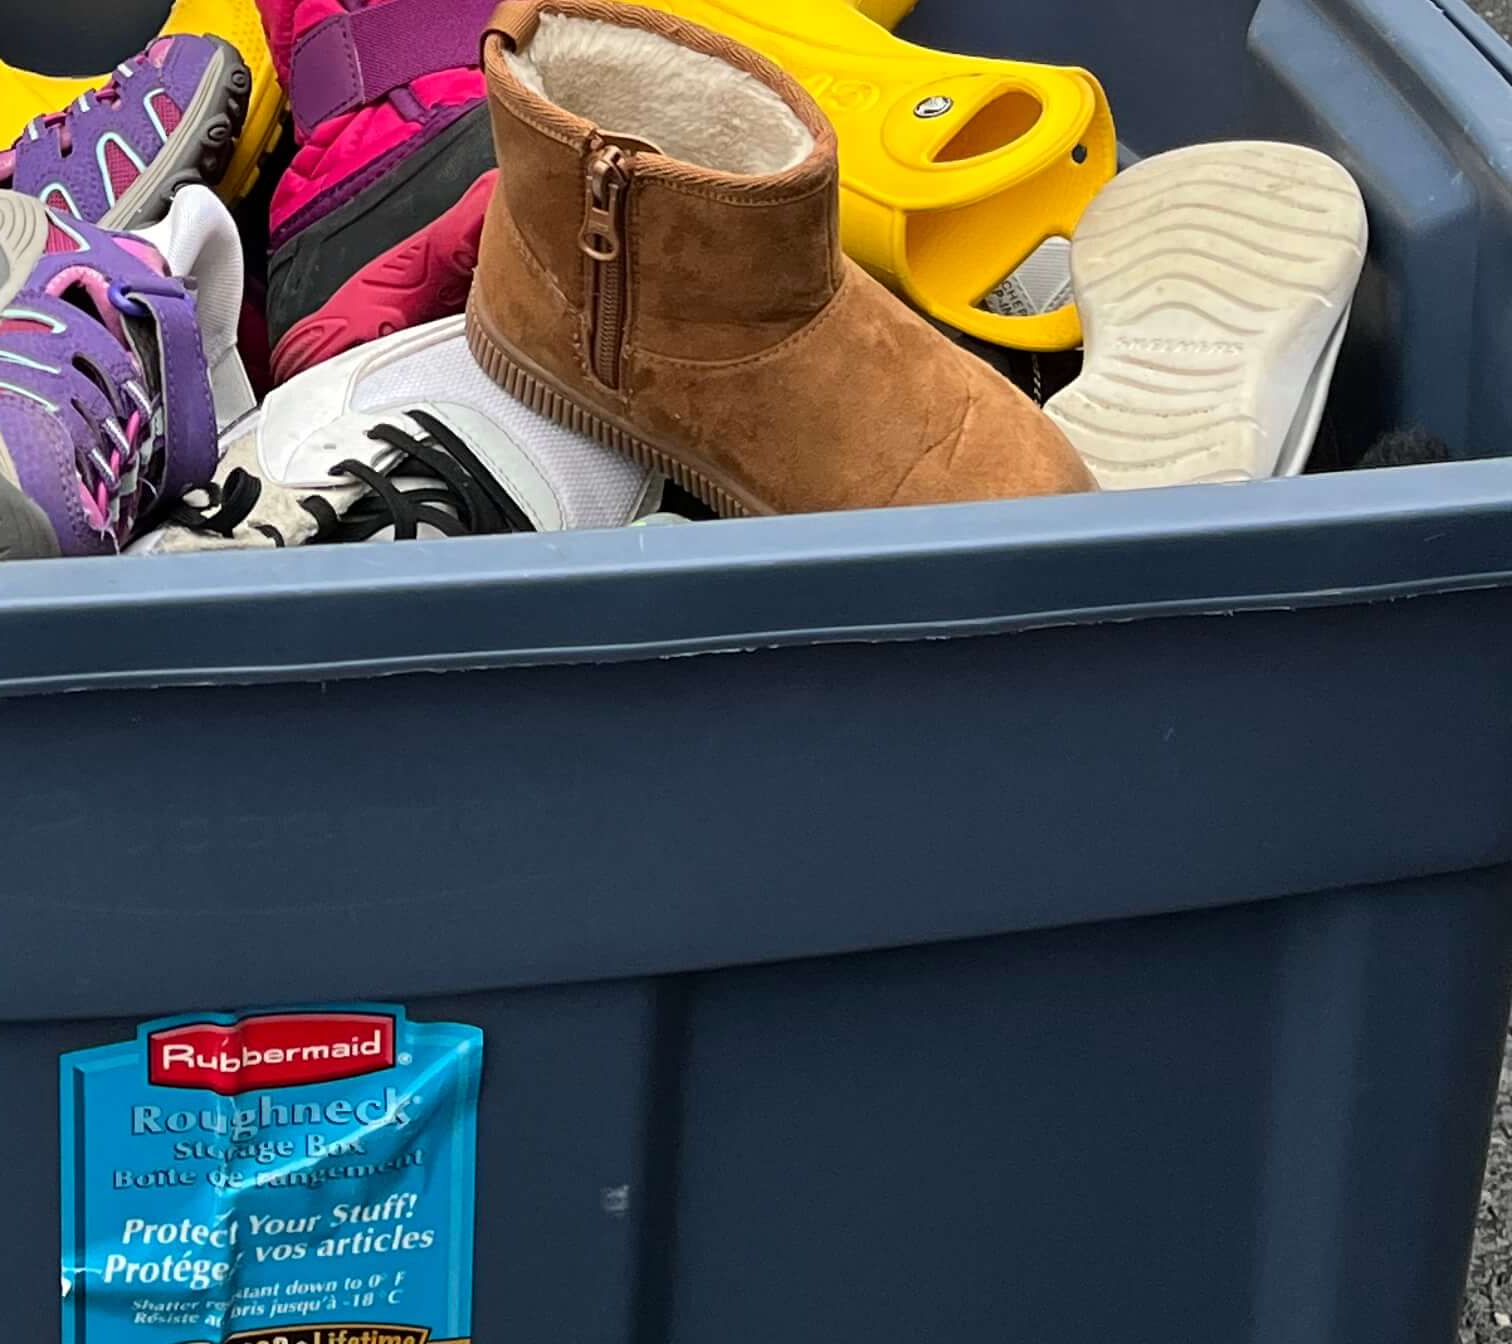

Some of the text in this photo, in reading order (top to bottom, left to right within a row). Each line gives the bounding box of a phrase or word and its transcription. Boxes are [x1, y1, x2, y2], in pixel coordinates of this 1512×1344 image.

[162, 1028, 381, 1073] Rubbermaid
[132, 1087, 412, 1142] Roughneck
[174, 1134, 366, 1163] Storage Box
[122, 1192, 418, 1249] Protect Your Stuff!
[255, 1242, 308, 1263] vos
[316, 1224, 436, 1258] articles
[285, 1279, 339, 1296] down
[344, 1277, 363, 1291] to
